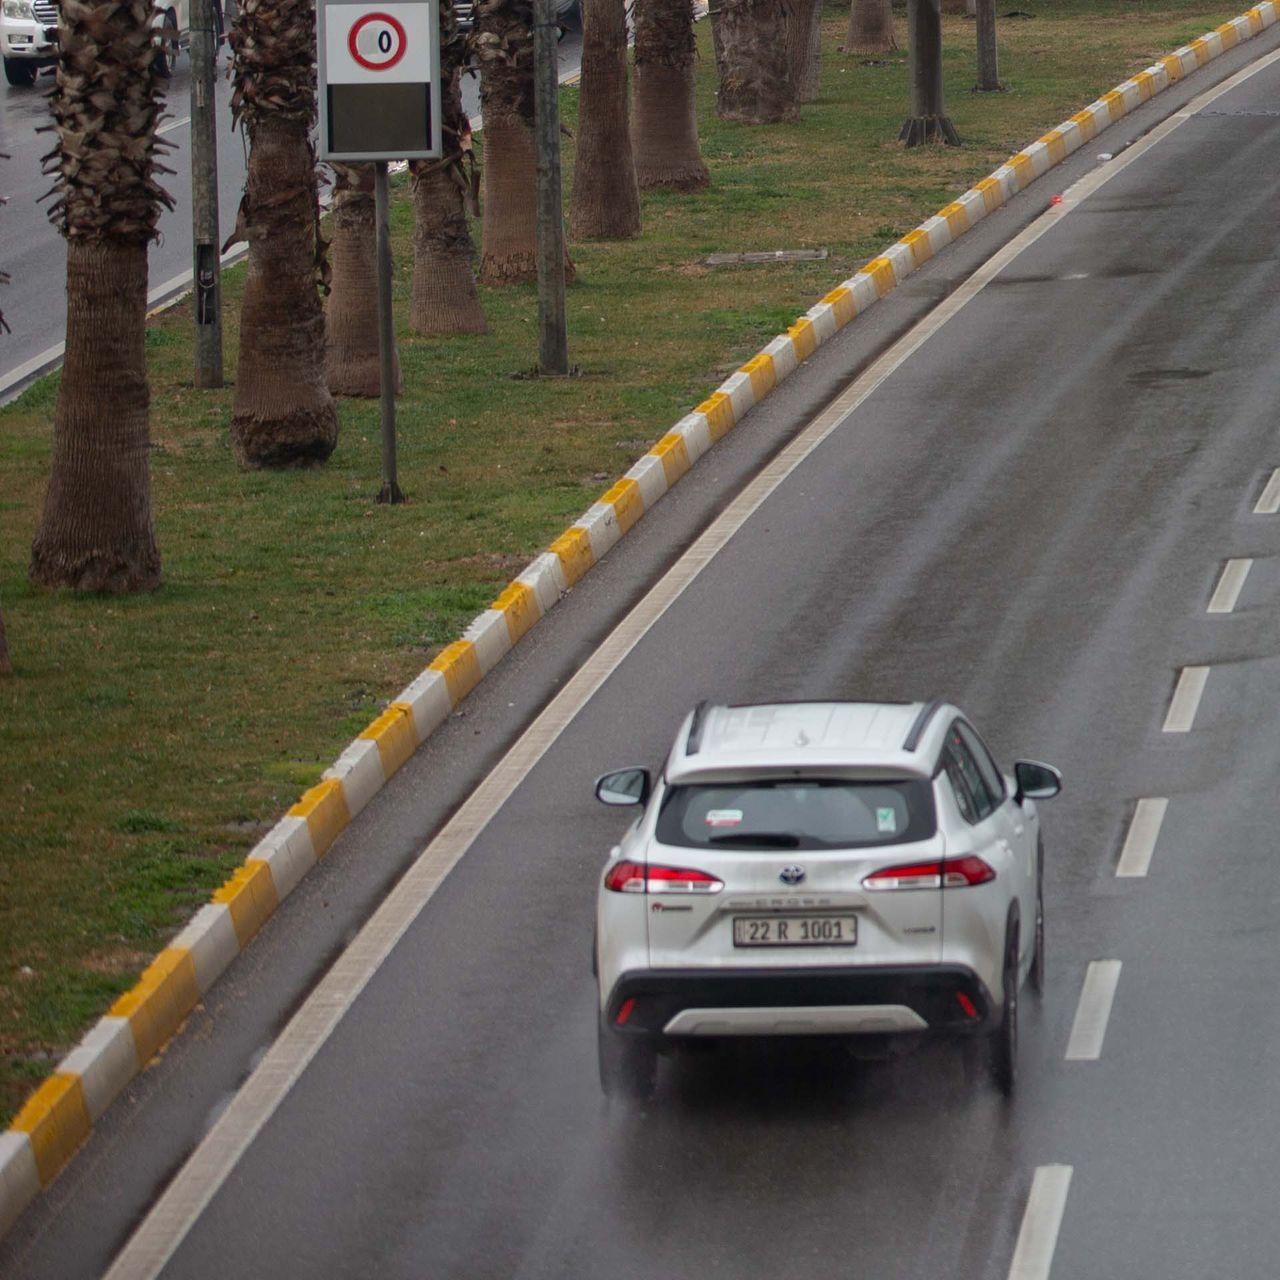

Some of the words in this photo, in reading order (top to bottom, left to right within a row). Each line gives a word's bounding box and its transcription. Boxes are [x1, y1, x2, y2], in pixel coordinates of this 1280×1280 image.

[749, 922, 771, 941] 22
[778, 922, 789, 940] R
[800, 921, 843, 940] 1001
